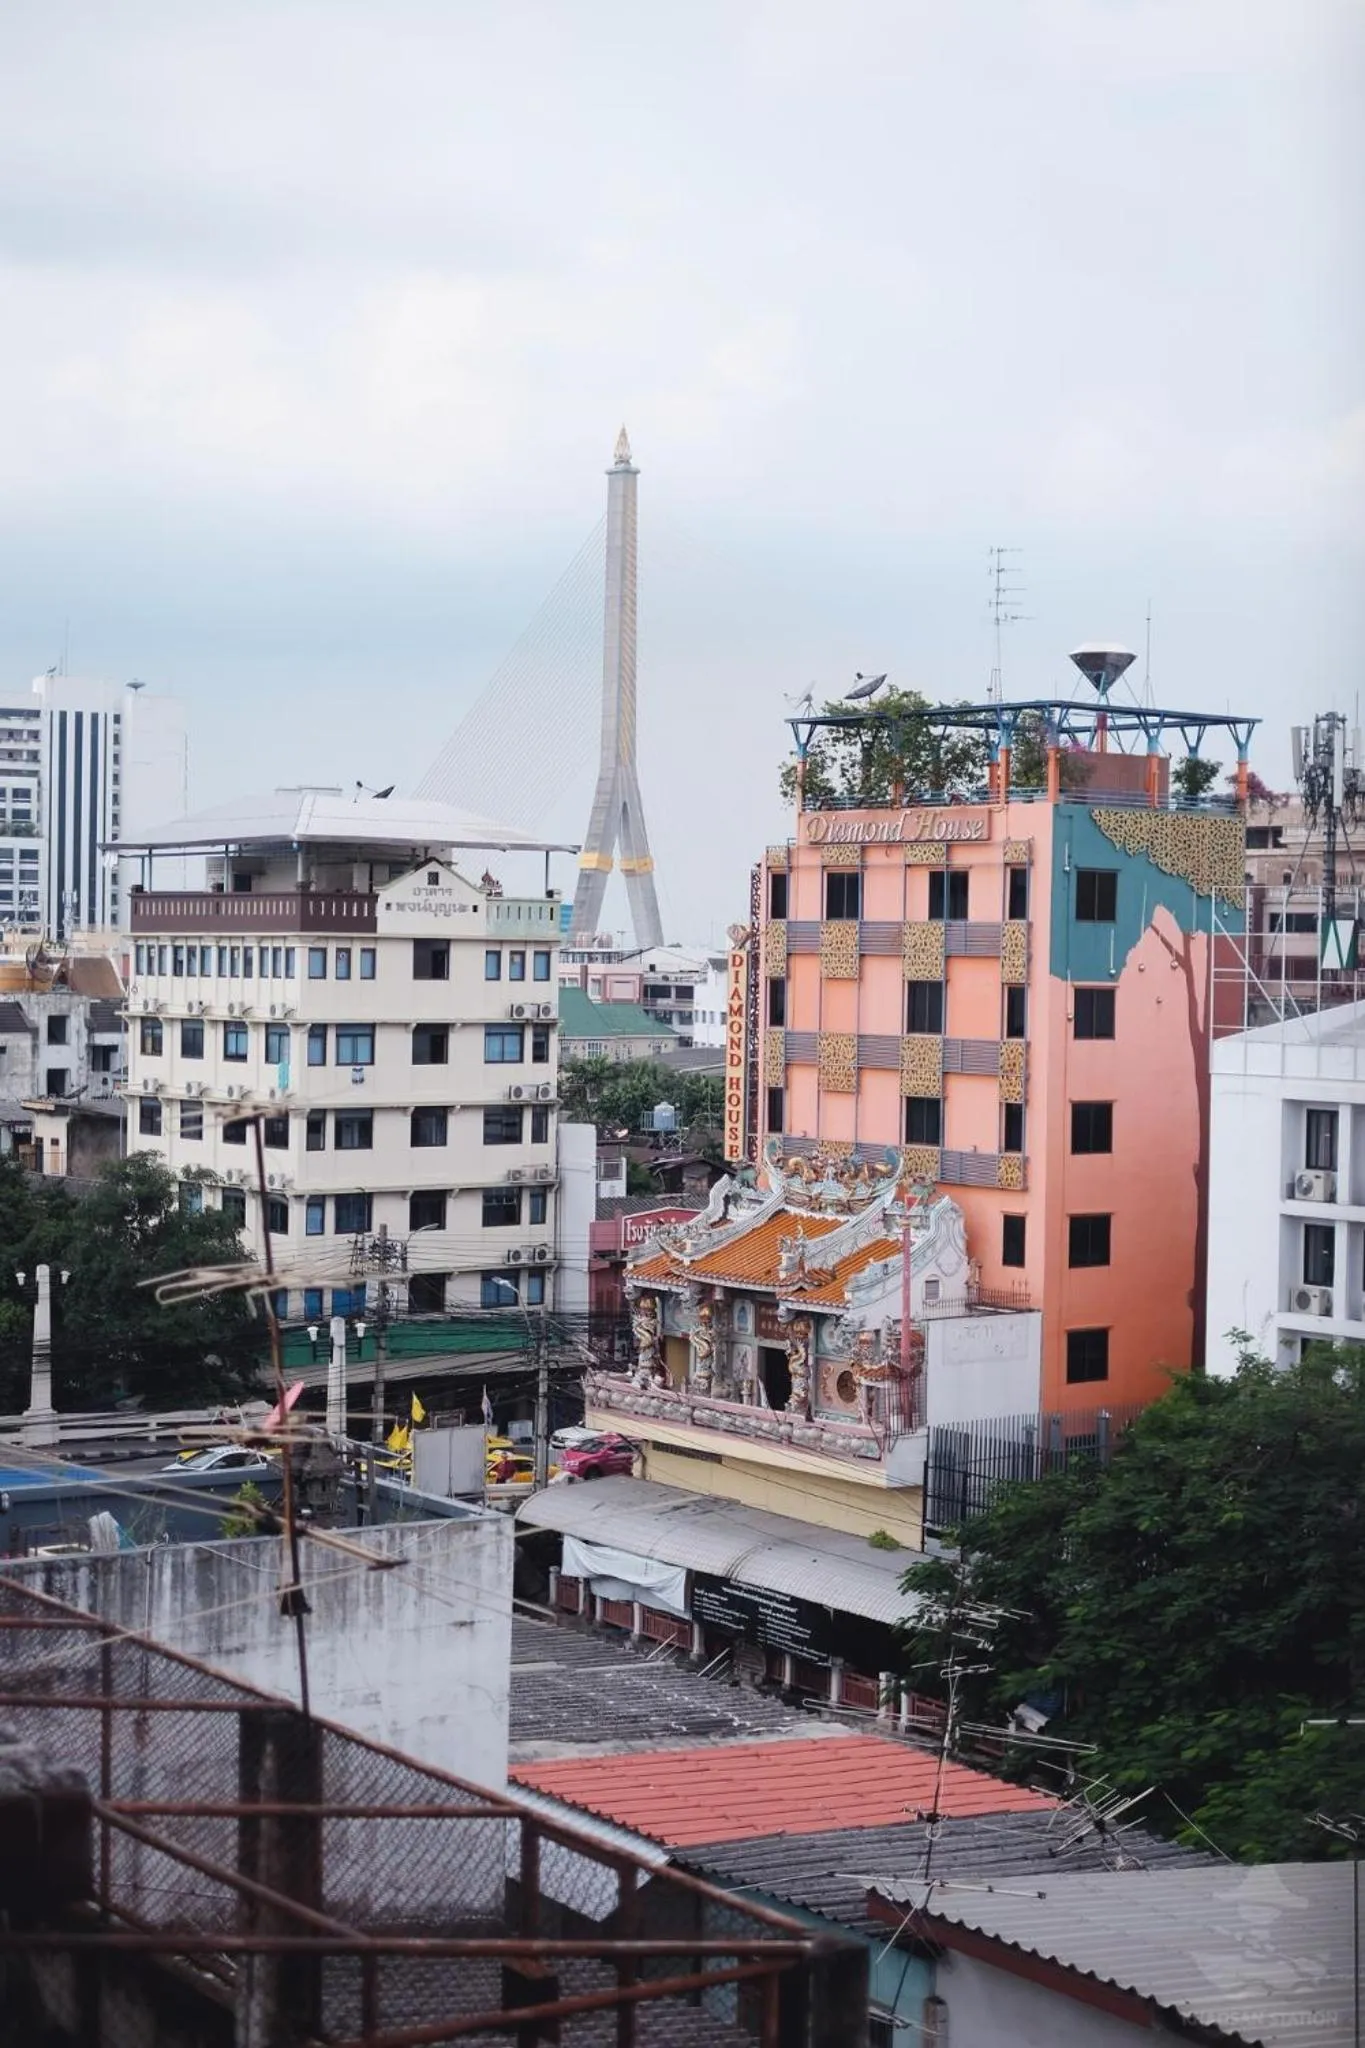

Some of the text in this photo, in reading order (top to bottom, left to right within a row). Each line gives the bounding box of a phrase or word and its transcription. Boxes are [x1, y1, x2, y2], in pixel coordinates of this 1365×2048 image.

[807, 811, 984, 842] Diamond House
[728, 954, 744, 1158] DIAMOND HOUSE
